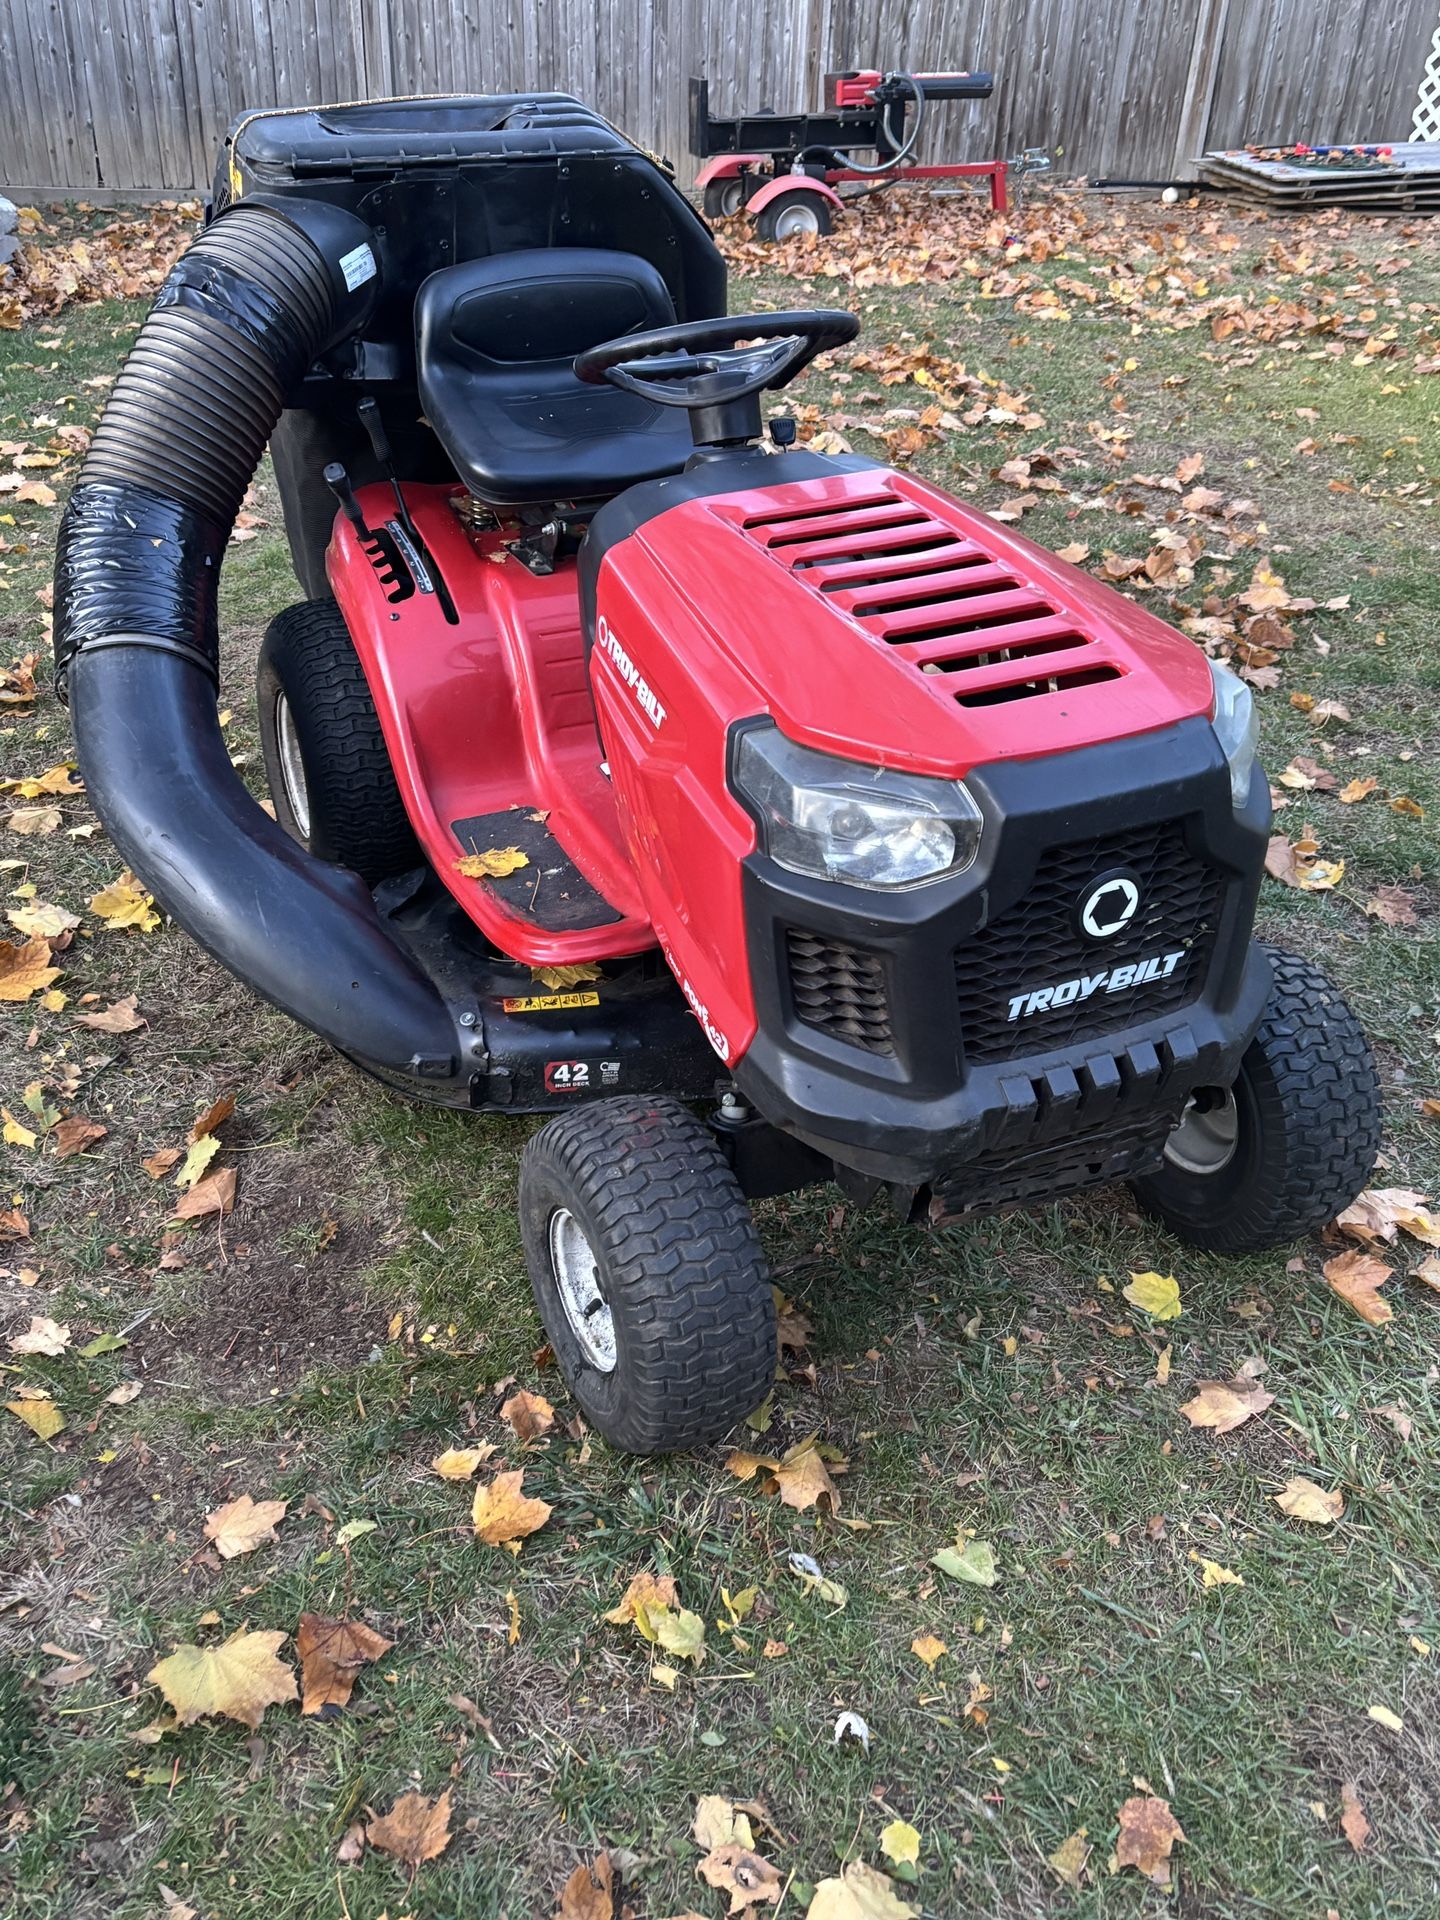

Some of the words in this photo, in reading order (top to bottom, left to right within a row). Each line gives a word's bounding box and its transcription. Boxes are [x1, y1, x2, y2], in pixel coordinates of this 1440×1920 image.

[607, 629, 667, 730] TROY-BILT
[1007, 950, 1185, 1022] TROY-BILT
[553, 1063, 589, 1082] 42
